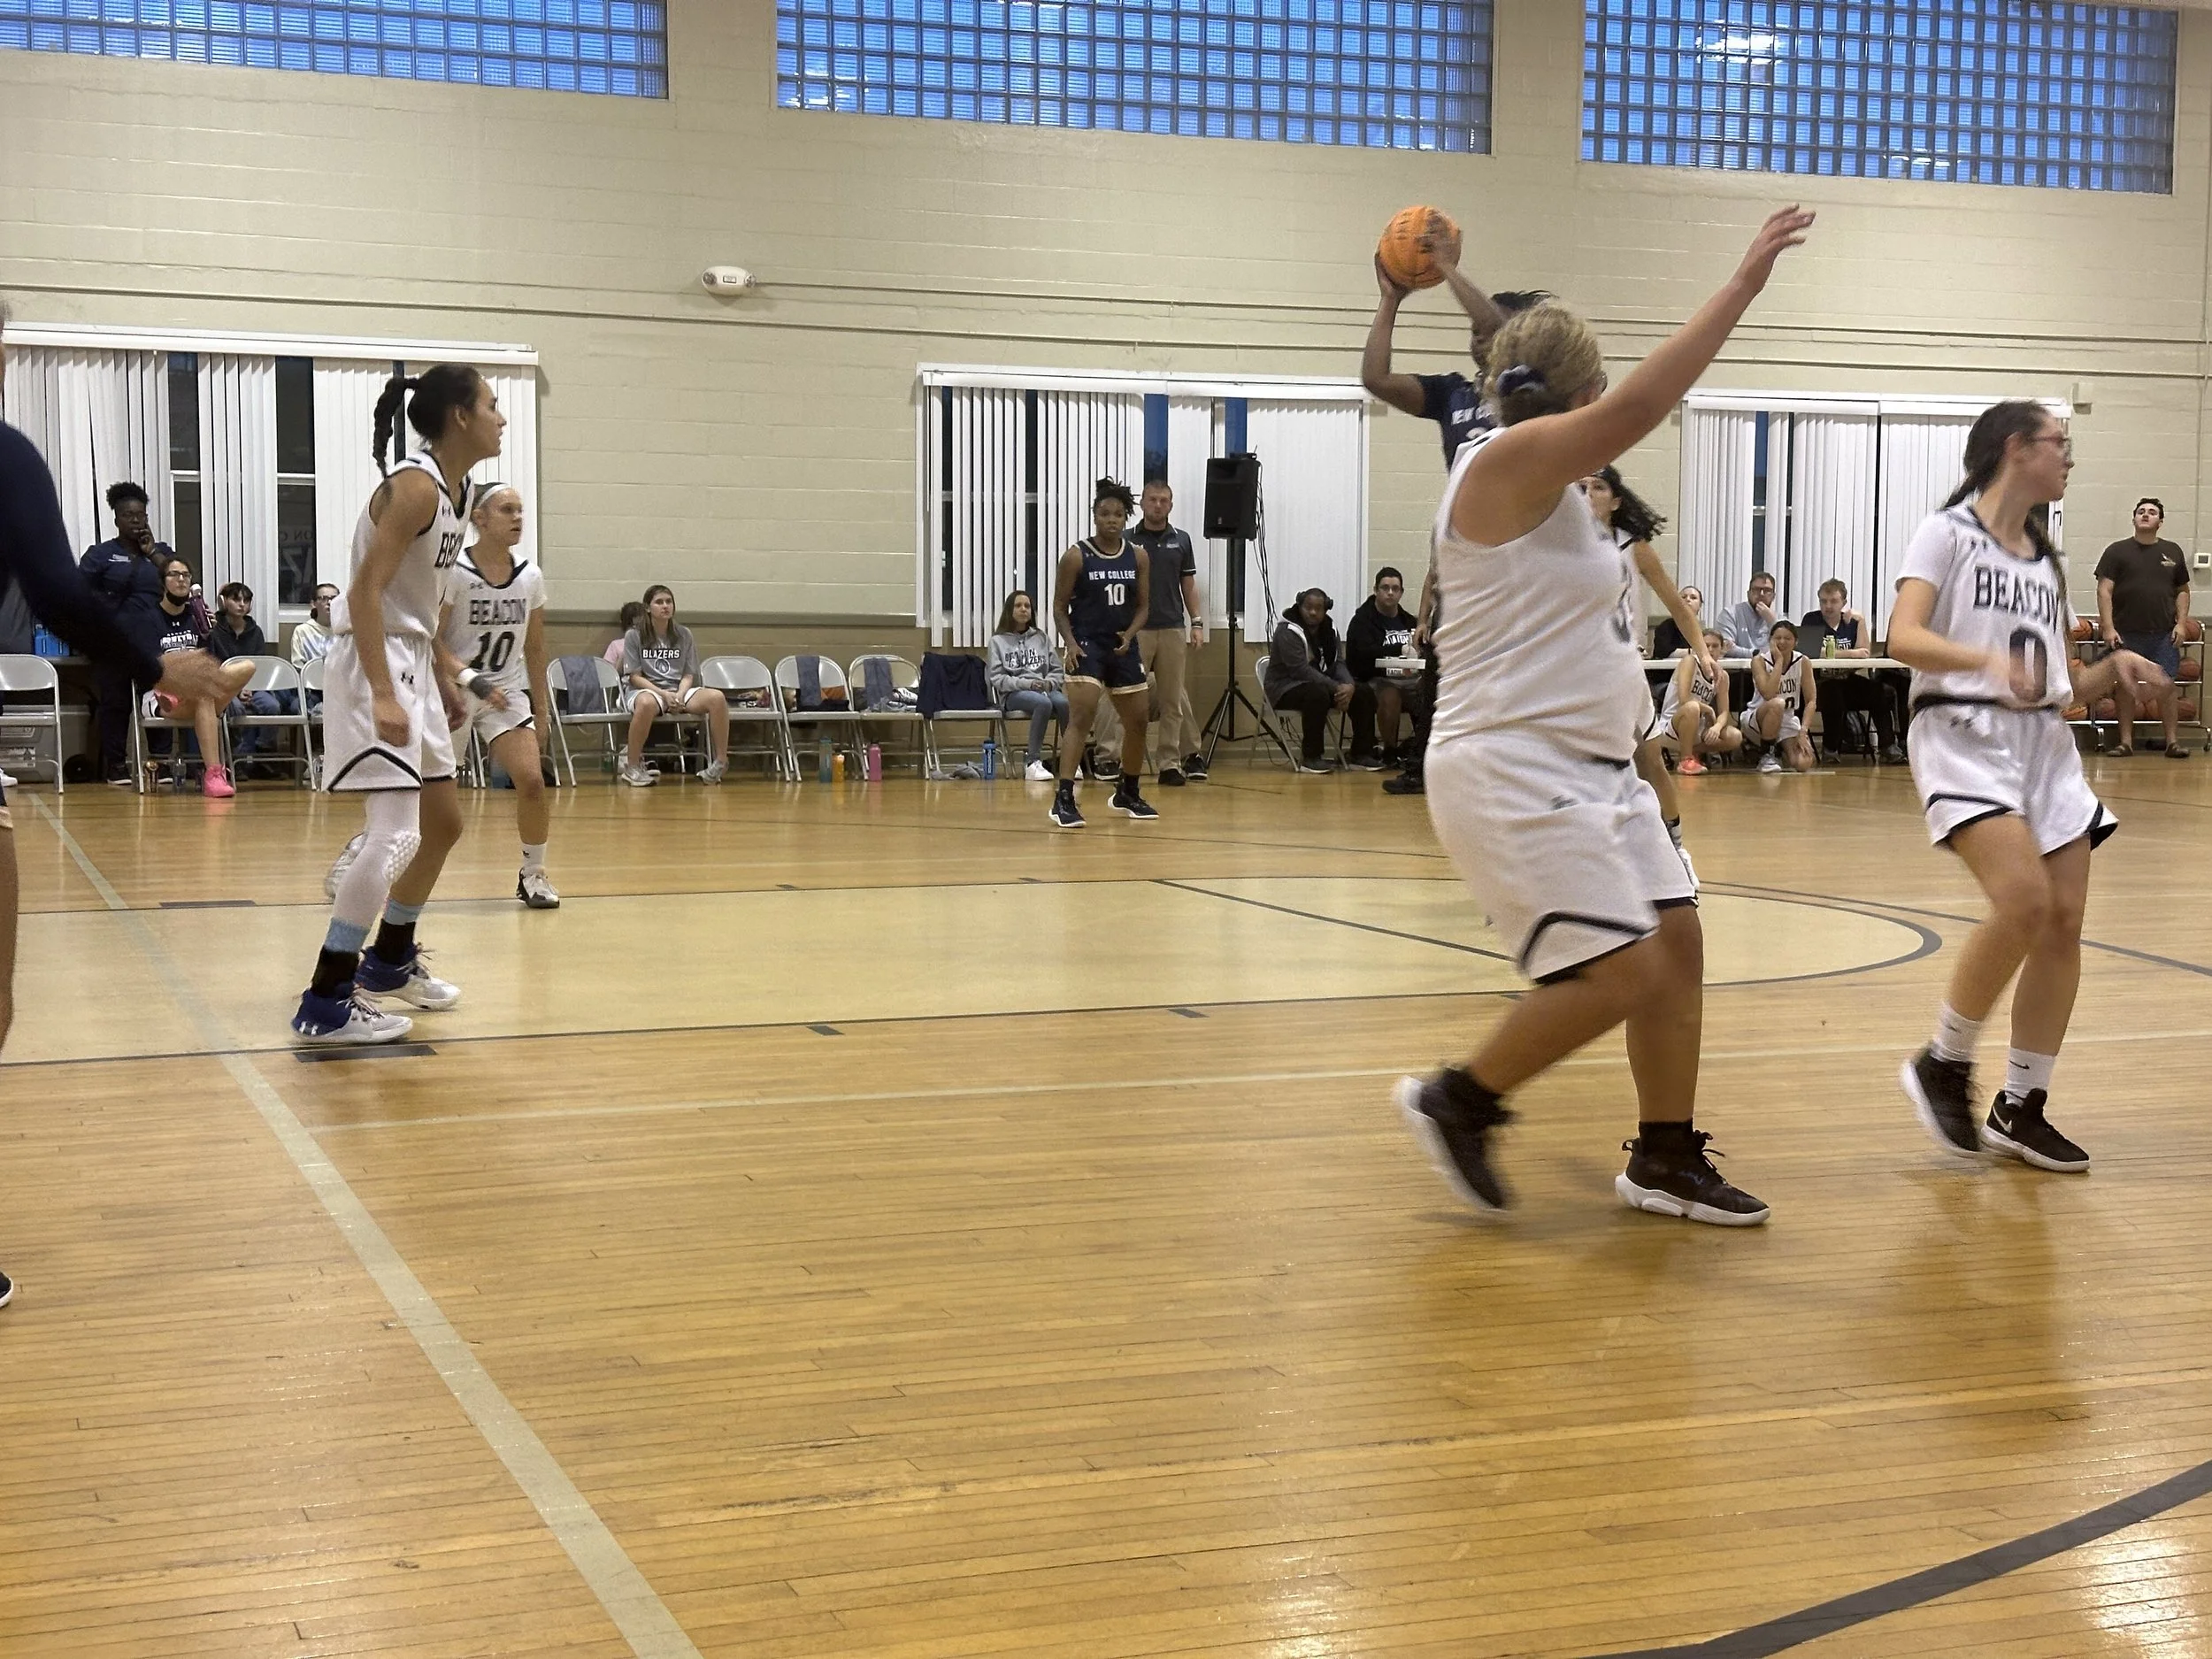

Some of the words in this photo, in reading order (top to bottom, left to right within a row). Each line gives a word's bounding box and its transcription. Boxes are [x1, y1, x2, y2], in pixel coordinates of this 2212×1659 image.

[1088, 571, 1105, 580] NEW
[1108, 570, 1135, 580] COLLEGE
[1104, 583, 1125, 606] 10
[469, 599, 526, 625] BEACON
[468, 631, 515, 672] 10
[642, 649, 680, 659] BLAZERS
[2009, 625, 2047, 703] 0
